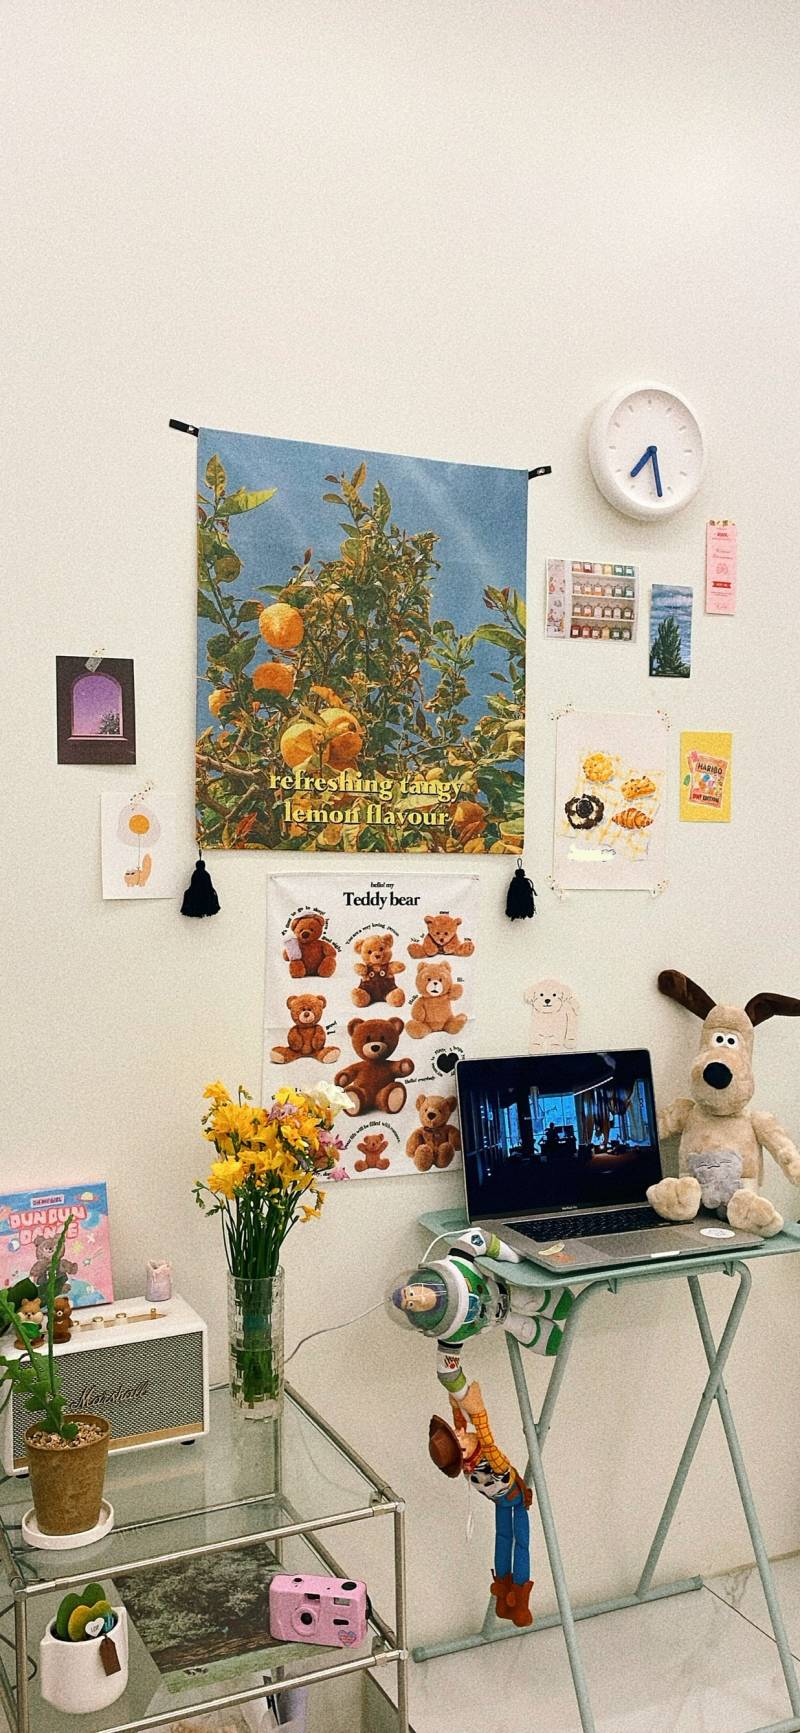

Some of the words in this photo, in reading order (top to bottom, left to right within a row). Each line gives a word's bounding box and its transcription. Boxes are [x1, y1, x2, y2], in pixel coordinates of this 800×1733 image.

[270, 771, 393, 800] refreshing
[400, 776, 463, 802] tangy
[284, 802, 359, 824] lemon
[366, 803, 450, 826] flavour
[343, 891, 388, 910] Teddy
[389, 891, 421, 906] bear
[9, 1210, 47, 1228] DUN
[47, 1205, 87, 1225] DUN
[68, 1380, 149, 1411] Marshall
